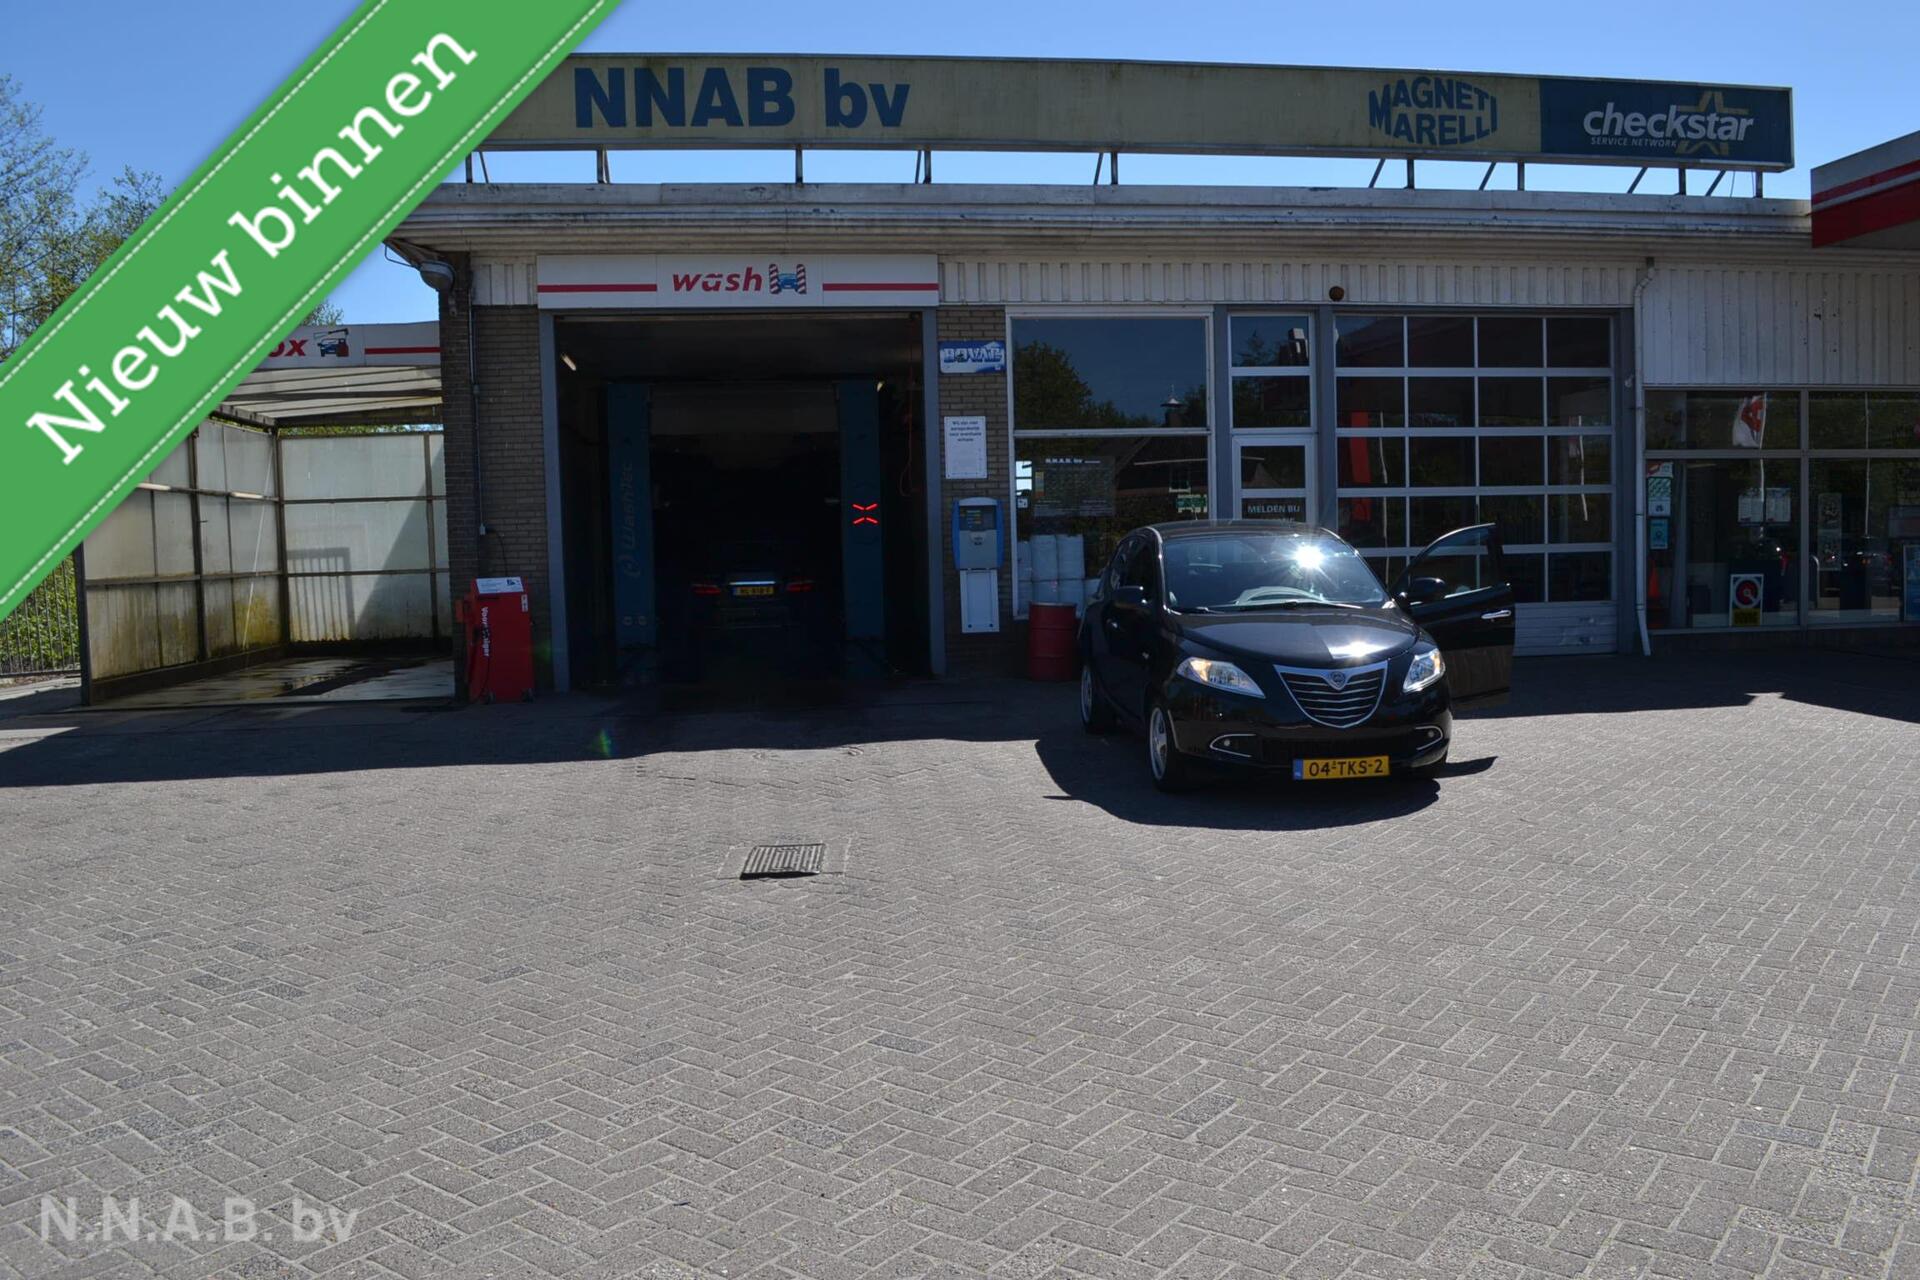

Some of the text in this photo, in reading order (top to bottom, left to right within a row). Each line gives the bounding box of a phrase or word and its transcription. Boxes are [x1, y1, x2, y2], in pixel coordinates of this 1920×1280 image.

[574, 67, 911, 129] NNAB bv
[1368, 76, 1497, 113] MAGNETI
[1583, 101, 1755, 142] checkstar
[1590, 136, 1678, 148] SERVICE NETWORK
[672, 265, 764, 292] wash
[1247, 503, 1285, 513] MELDEN
